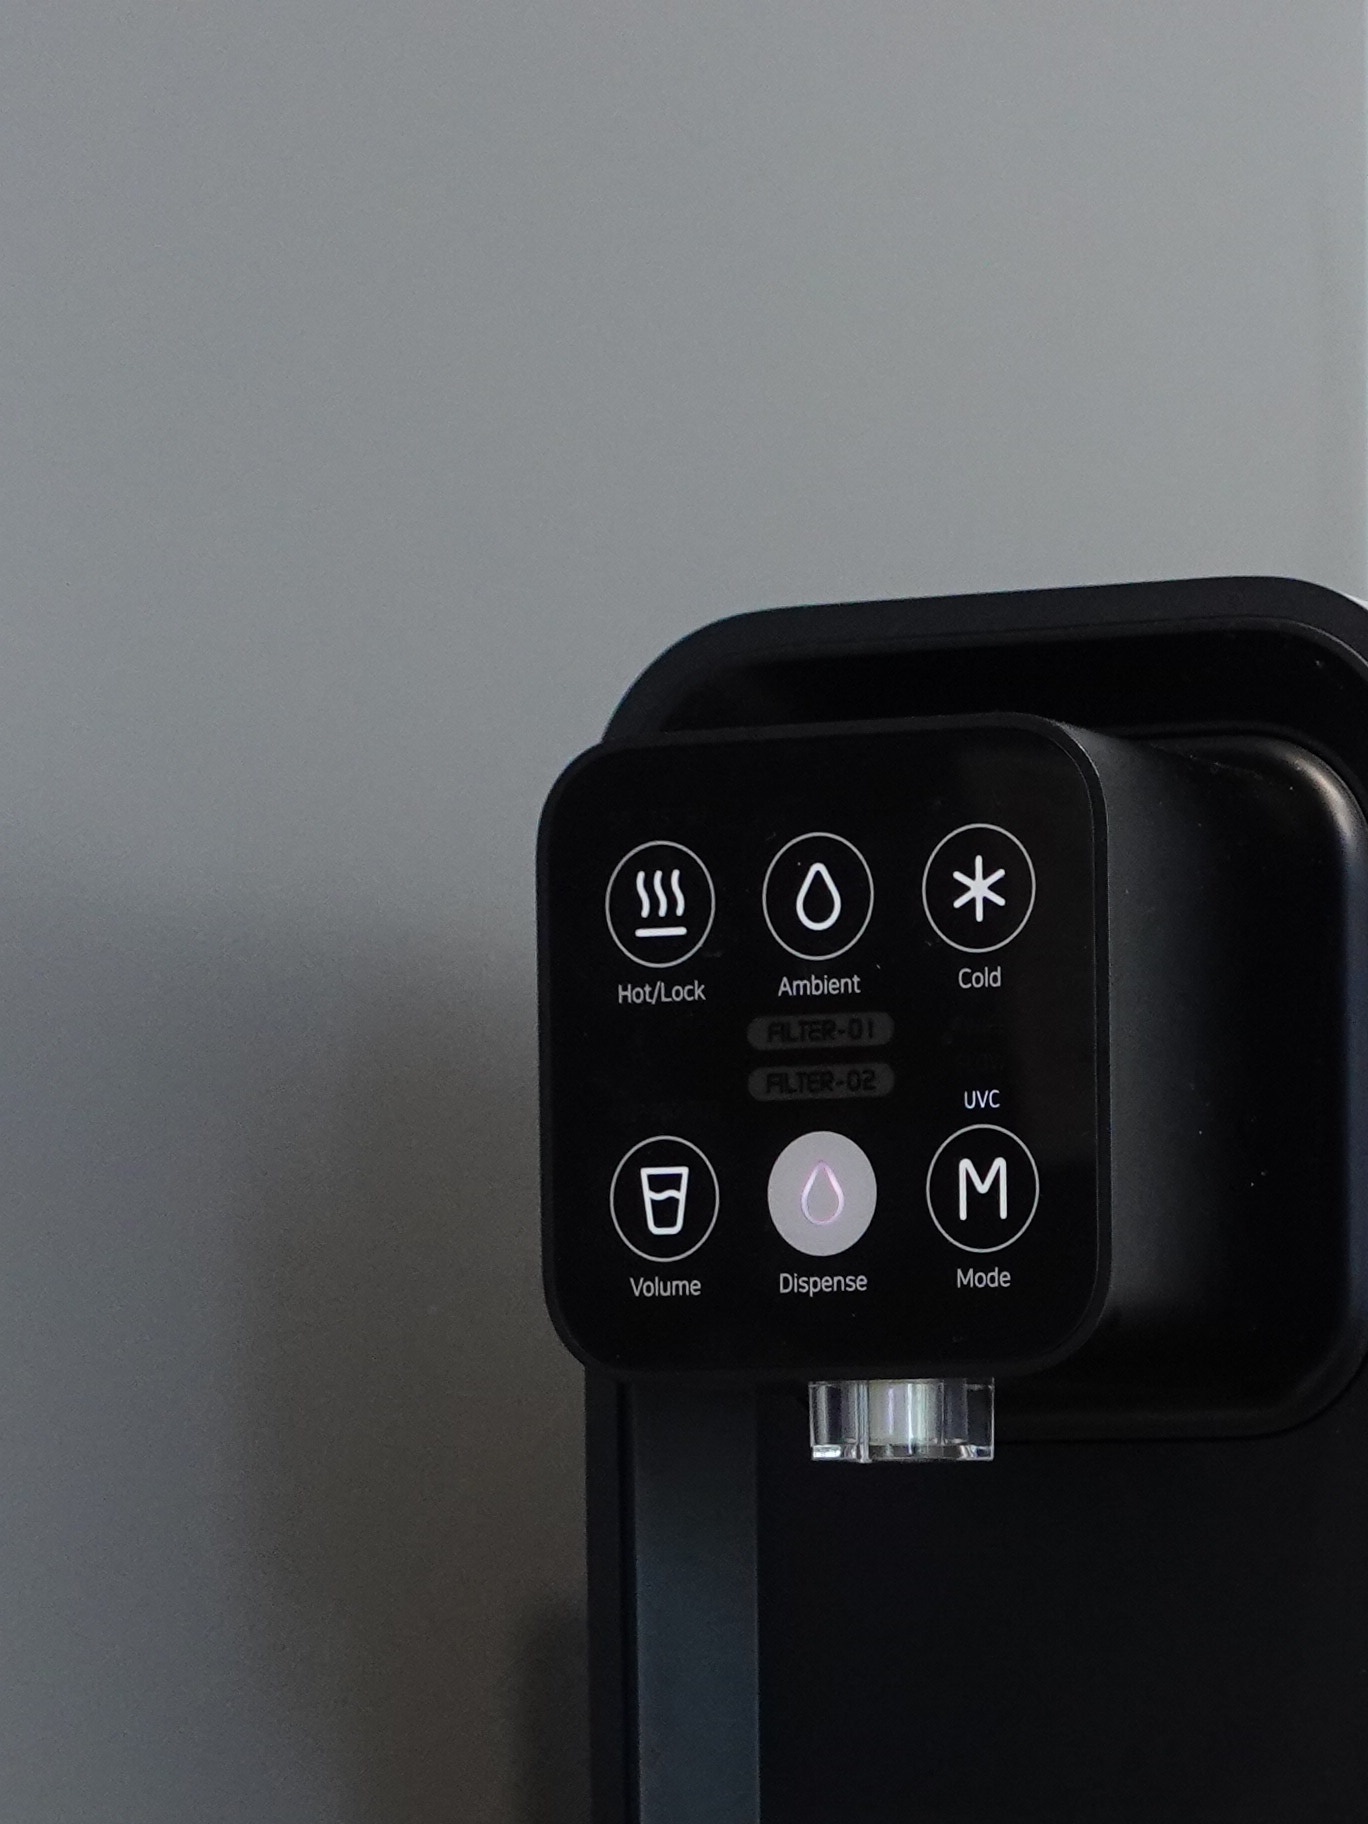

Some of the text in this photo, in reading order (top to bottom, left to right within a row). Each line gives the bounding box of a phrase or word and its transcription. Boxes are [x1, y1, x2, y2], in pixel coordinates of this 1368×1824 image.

[778, 975, 861, 997] Ambient
[958, 966, 1002, 989] Cold
[618, 980, 706, 1005] Hot/Lock
[964, 1089, 1001, 1110] UVC
[630, 1276, 702, 1297] Volume
[779, 1272, 868, 1298] Dispense
[956, 1266, 1011, 1289] Mode
